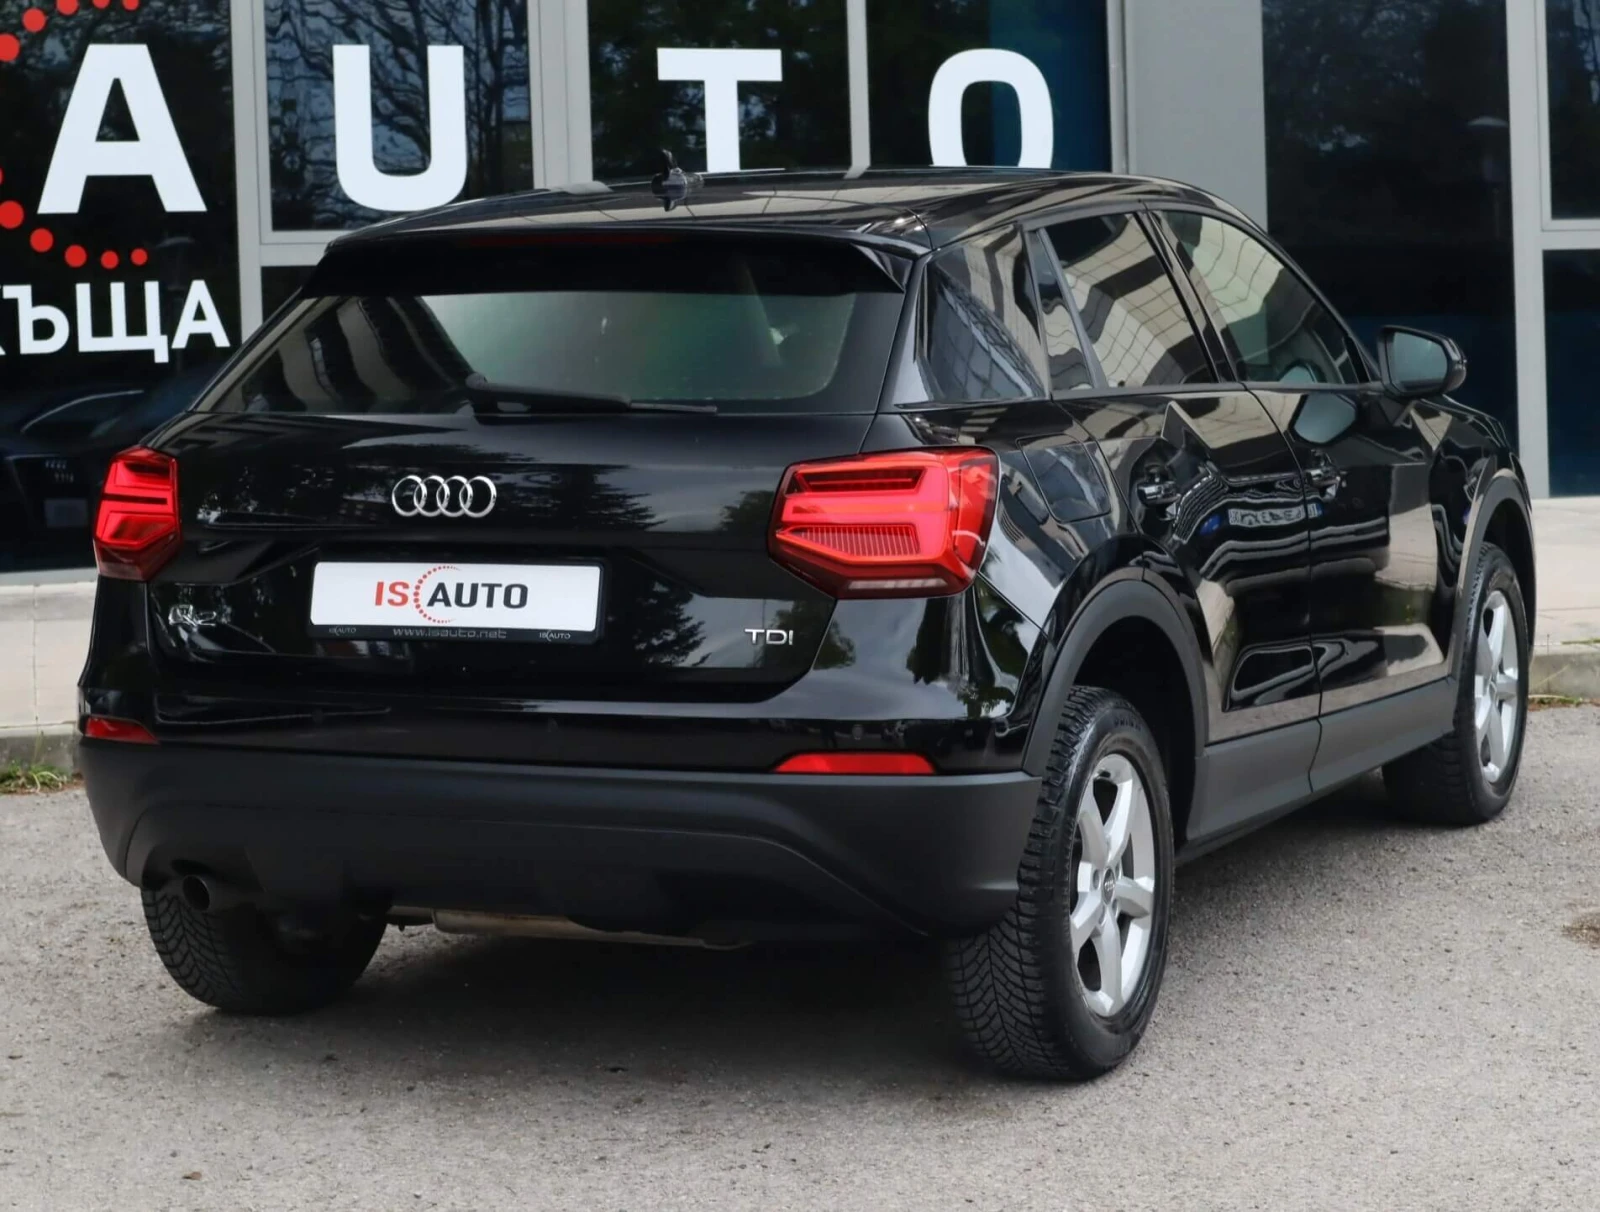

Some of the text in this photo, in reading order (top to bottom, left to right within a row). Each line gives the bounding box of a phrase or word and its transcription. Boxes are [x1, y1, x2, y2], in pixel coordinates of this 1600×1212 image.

[0, 279, 231, 364] ЪЩА
[374, 581, 529, 609] IS AUTO
[393, 627, 507, 639] www.isauto.net
[548, 632, 571, 640] AUTO
[744, 628, 794, 646] TDI
